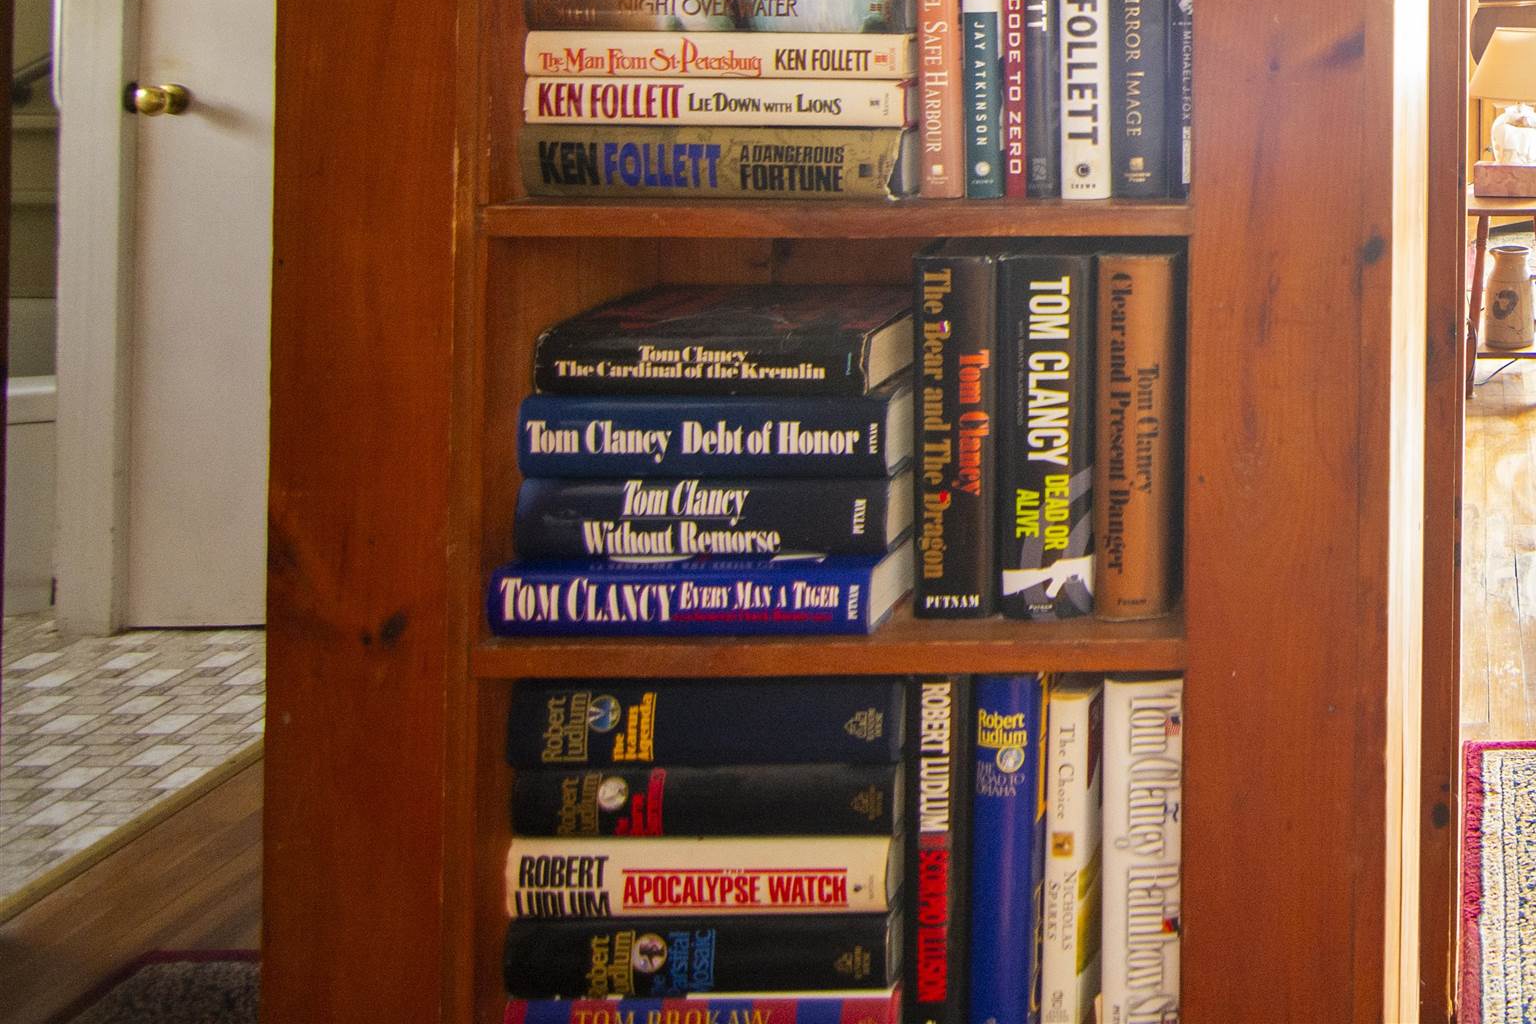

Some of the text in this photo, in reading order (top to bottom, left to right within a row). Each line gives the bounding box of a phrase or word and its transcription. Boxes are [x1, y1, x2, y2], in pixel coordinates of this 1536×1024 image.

[775, 48, 807, 71] KEN
[811, 49, 872, 72] FOLLETT
[974, 21, 987, 146] JAY ATKINSON
[1008, 75, 1021, 101] TO
[1125, 71, 1145, 137] IMAGE
[538, 140, 721, 188] KEN FOLLETT
[740, 144, 845, 164] A DANGEROUS
[1009, 112, 1022, 175] ZERO
[739, 165, 844, 192] FORTUNE
[555, 361, 825, 380] The Cardinal of the Kremlin
[639, 346, 748, 365] Tom Clancy
[1027, 275, 1070, 466] TOM CLANCY
[526, 420, 860, 464] Tom Clancy Debt of Honor
[622, 480, 750, 526] Tom Clancy
[1016, 488, 1040, 539] ALIVE
[1044, 474, 1070, 551] DEAD OR
[583, 521, 781, 555] Without Remorse
[500, 578, 560, 622] TOM
[566, 578, 677, 622] CLANCY
[679, 582, 731, 610] EVERY
[733, 582, 773, 610] MAN
[776, 586, 787, 609] A
[793, 581, 840, 609] TIGER
[925, 594, 980, 609] PUTNAM
[978, 708, 1025, 728] Robert
[1058, 723, 1076, 820] The Choice
[519, 855, 609, 889] ROBERT
[623, 875, 847, 904] APOCALYPSE WATCH
[1048, 879, 1059, 942] SPARKS
[1063, 869, 1077, 951] NICHOLAS
